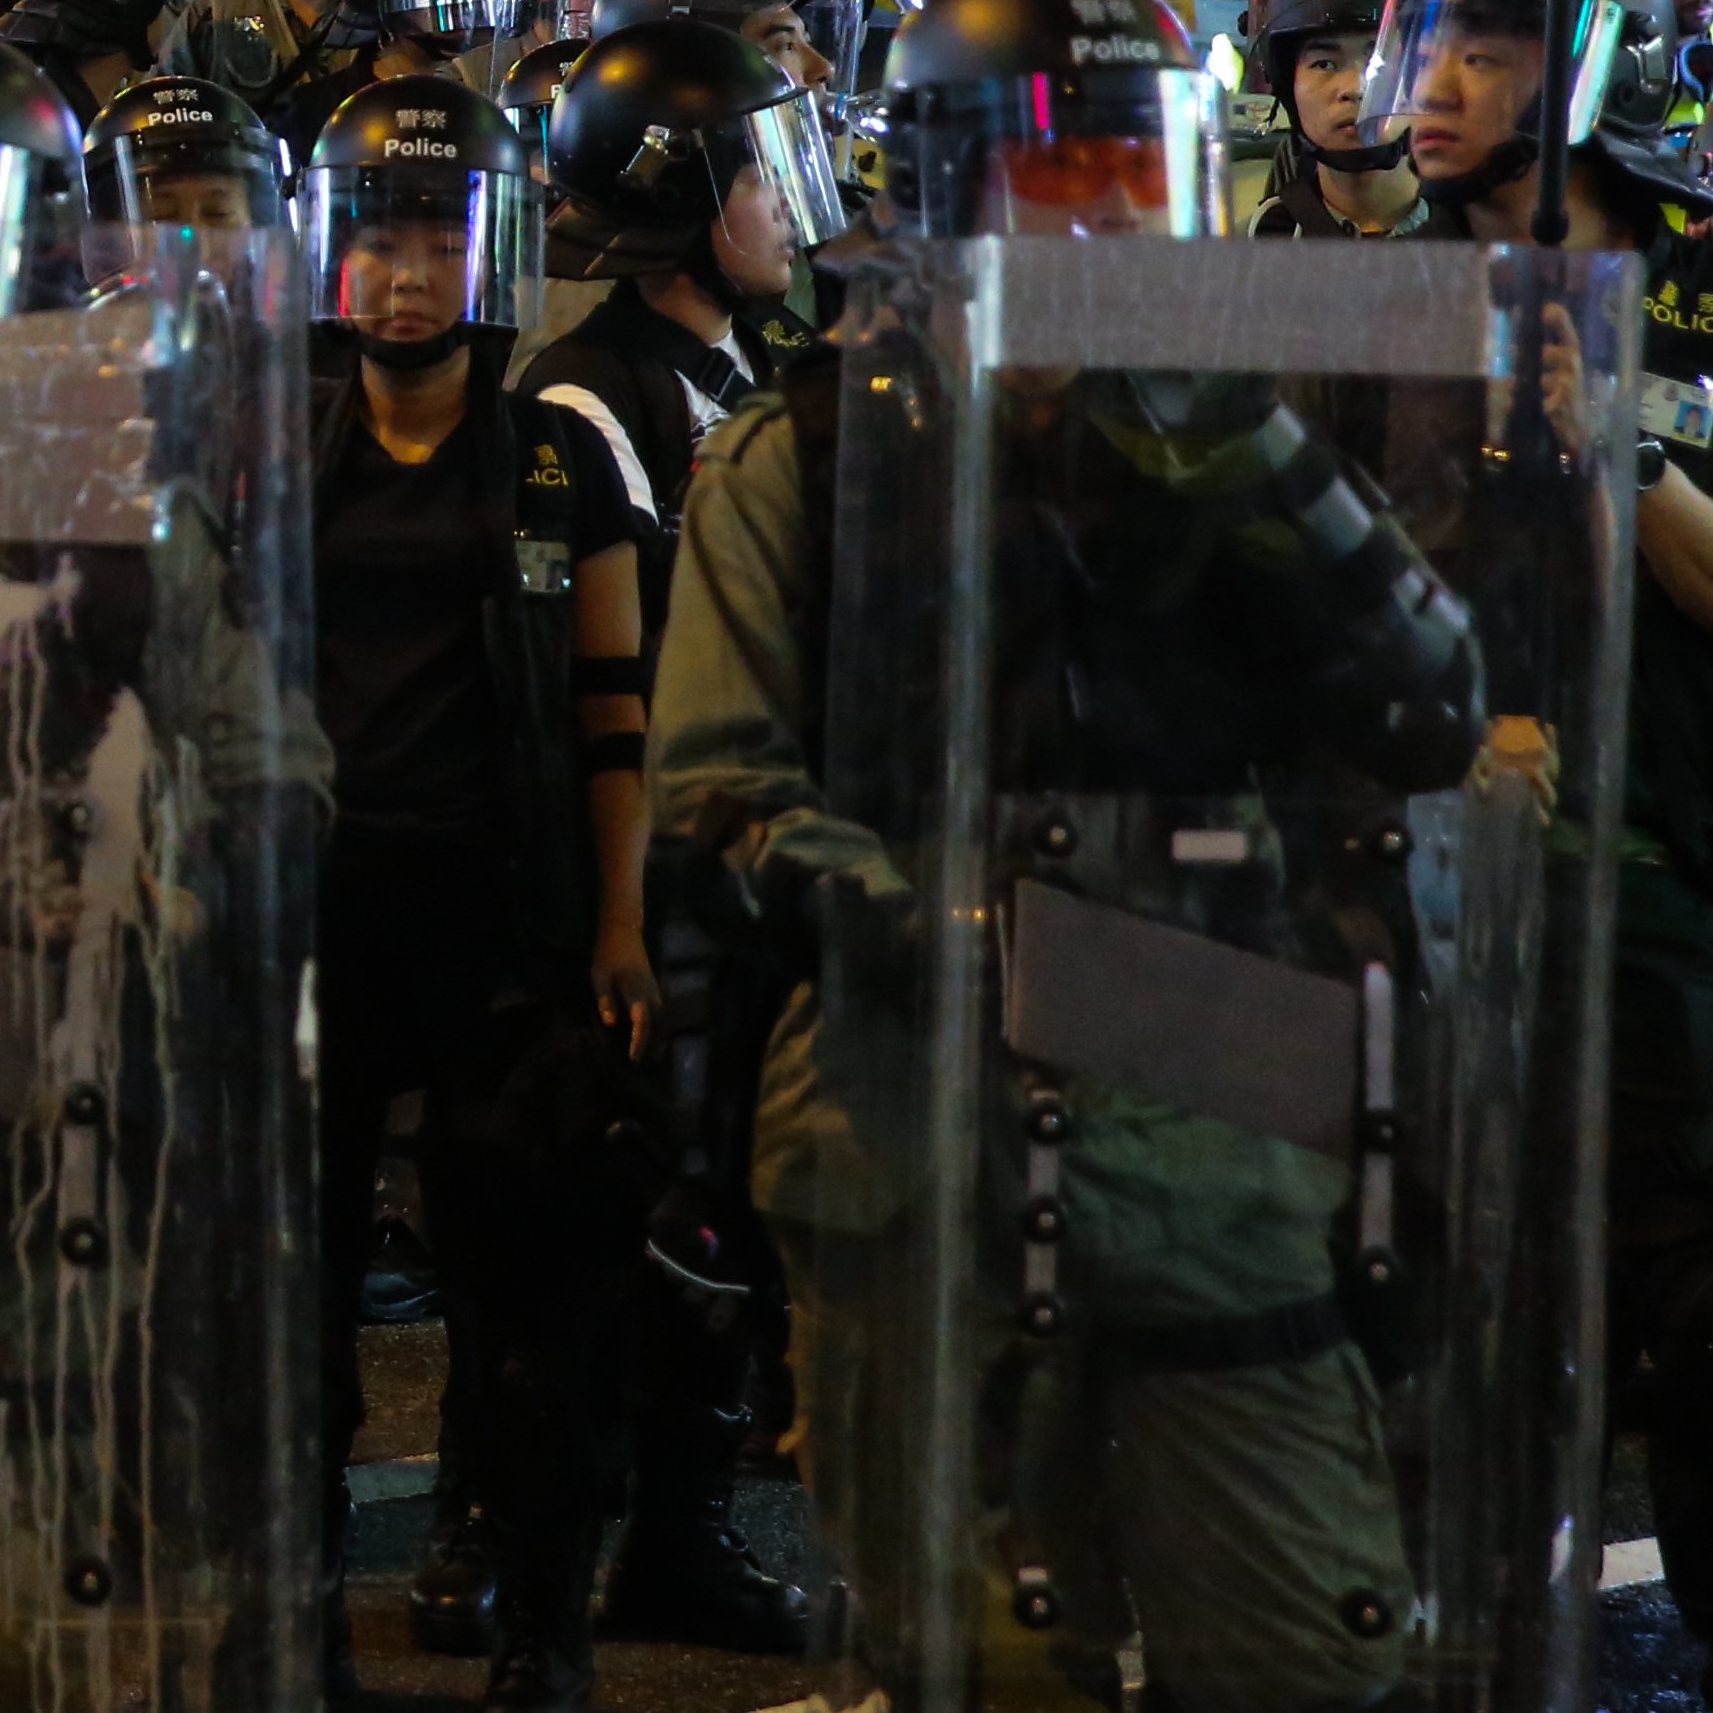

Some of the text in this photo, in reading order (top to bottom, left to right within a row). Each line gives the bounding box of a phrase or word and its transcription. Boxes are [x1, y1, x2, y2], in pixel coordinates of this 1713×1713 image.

[1071, 34, 1160, 64] Police
[147, 106, 213, 126] Police
[395, 108, 447, 130] 警察
[384, 137, 458, 160] Police
[1643, 296, 1713, 334] POLIC
